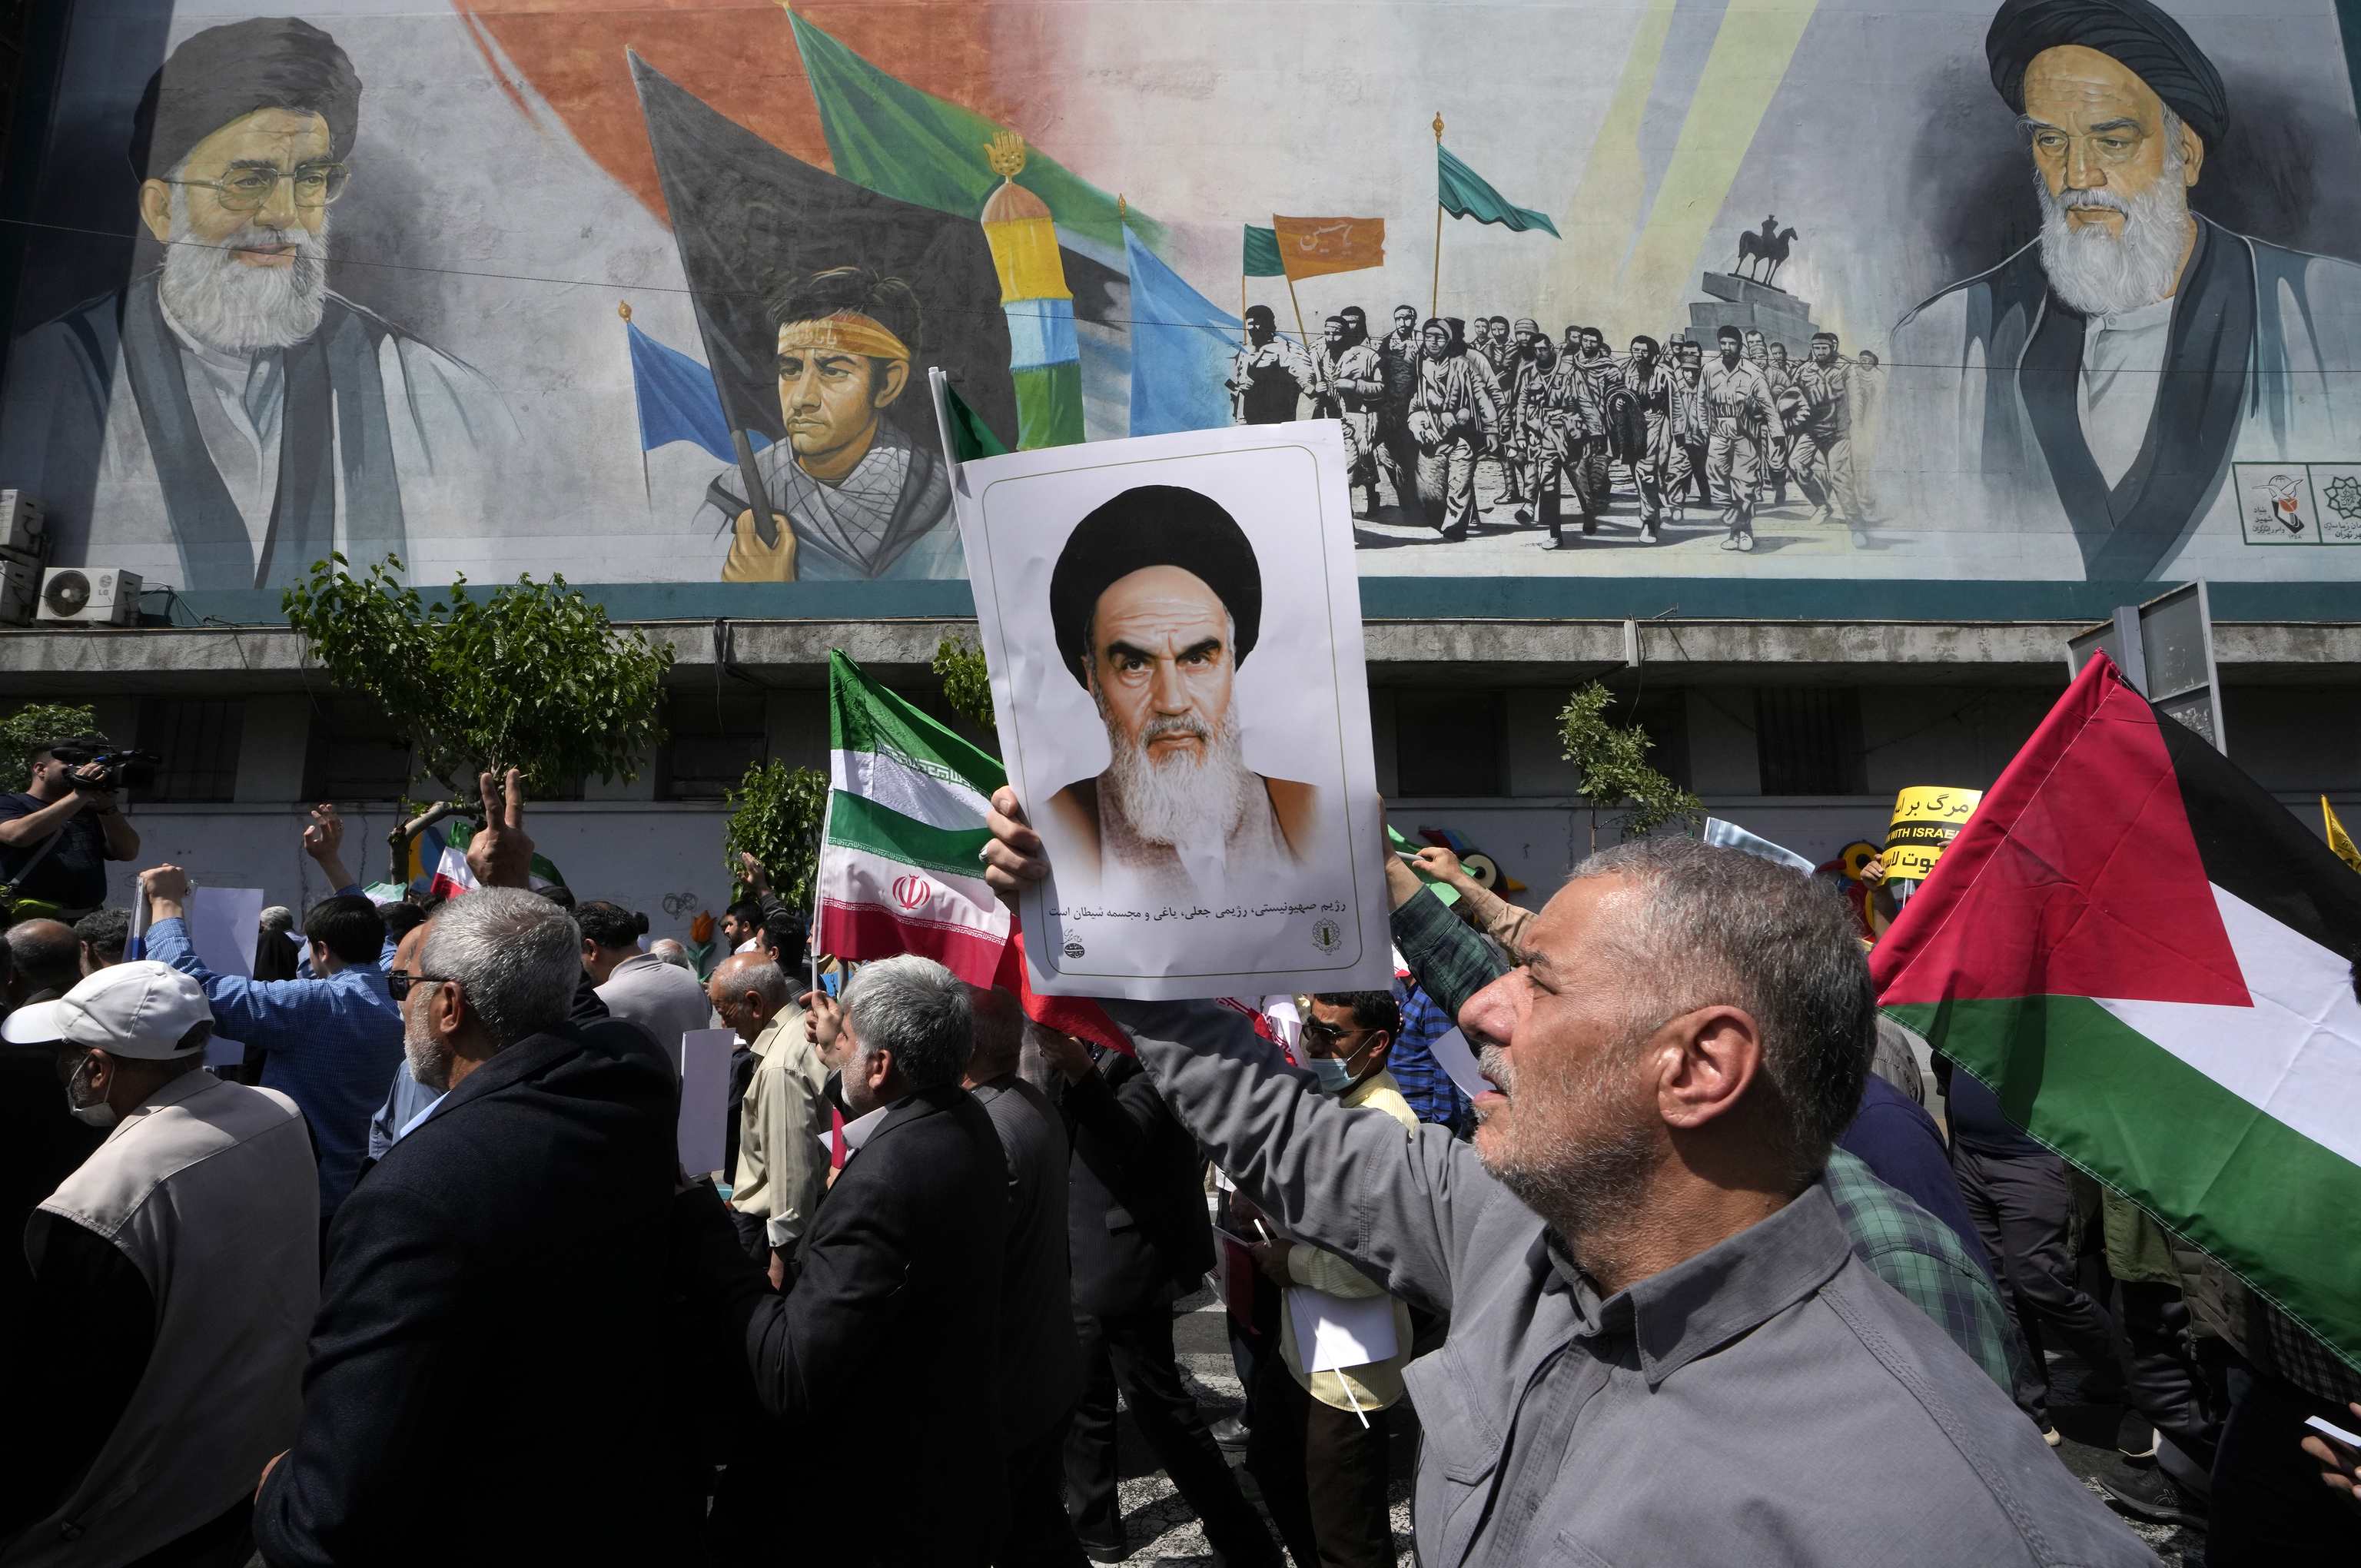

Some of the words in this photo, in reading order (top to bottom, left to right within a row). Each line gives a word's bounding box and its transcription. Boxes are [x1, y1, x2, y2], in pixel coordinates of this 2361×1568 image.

[2253, 507, 2267, 515] بنیاد
[2255, 515, 2273, 523] شهید
[2335, 530, 2353, 540] تهران
[1905, 801, 1920, 816] بر
[1927, 793, 1969, 817] مرگ
[1321, 900, 1347, 912] رژیم
[1049, 907, 1071, 917] است
[1073, 907, 1104, 921] شیطان
[1106, 911, 1141, 921] مجسمه
[1144, 912, 1151, 922] و
[1154, 907, 1177, 921] یاغی
[1215, 905, 1247, 919] رژیمی
